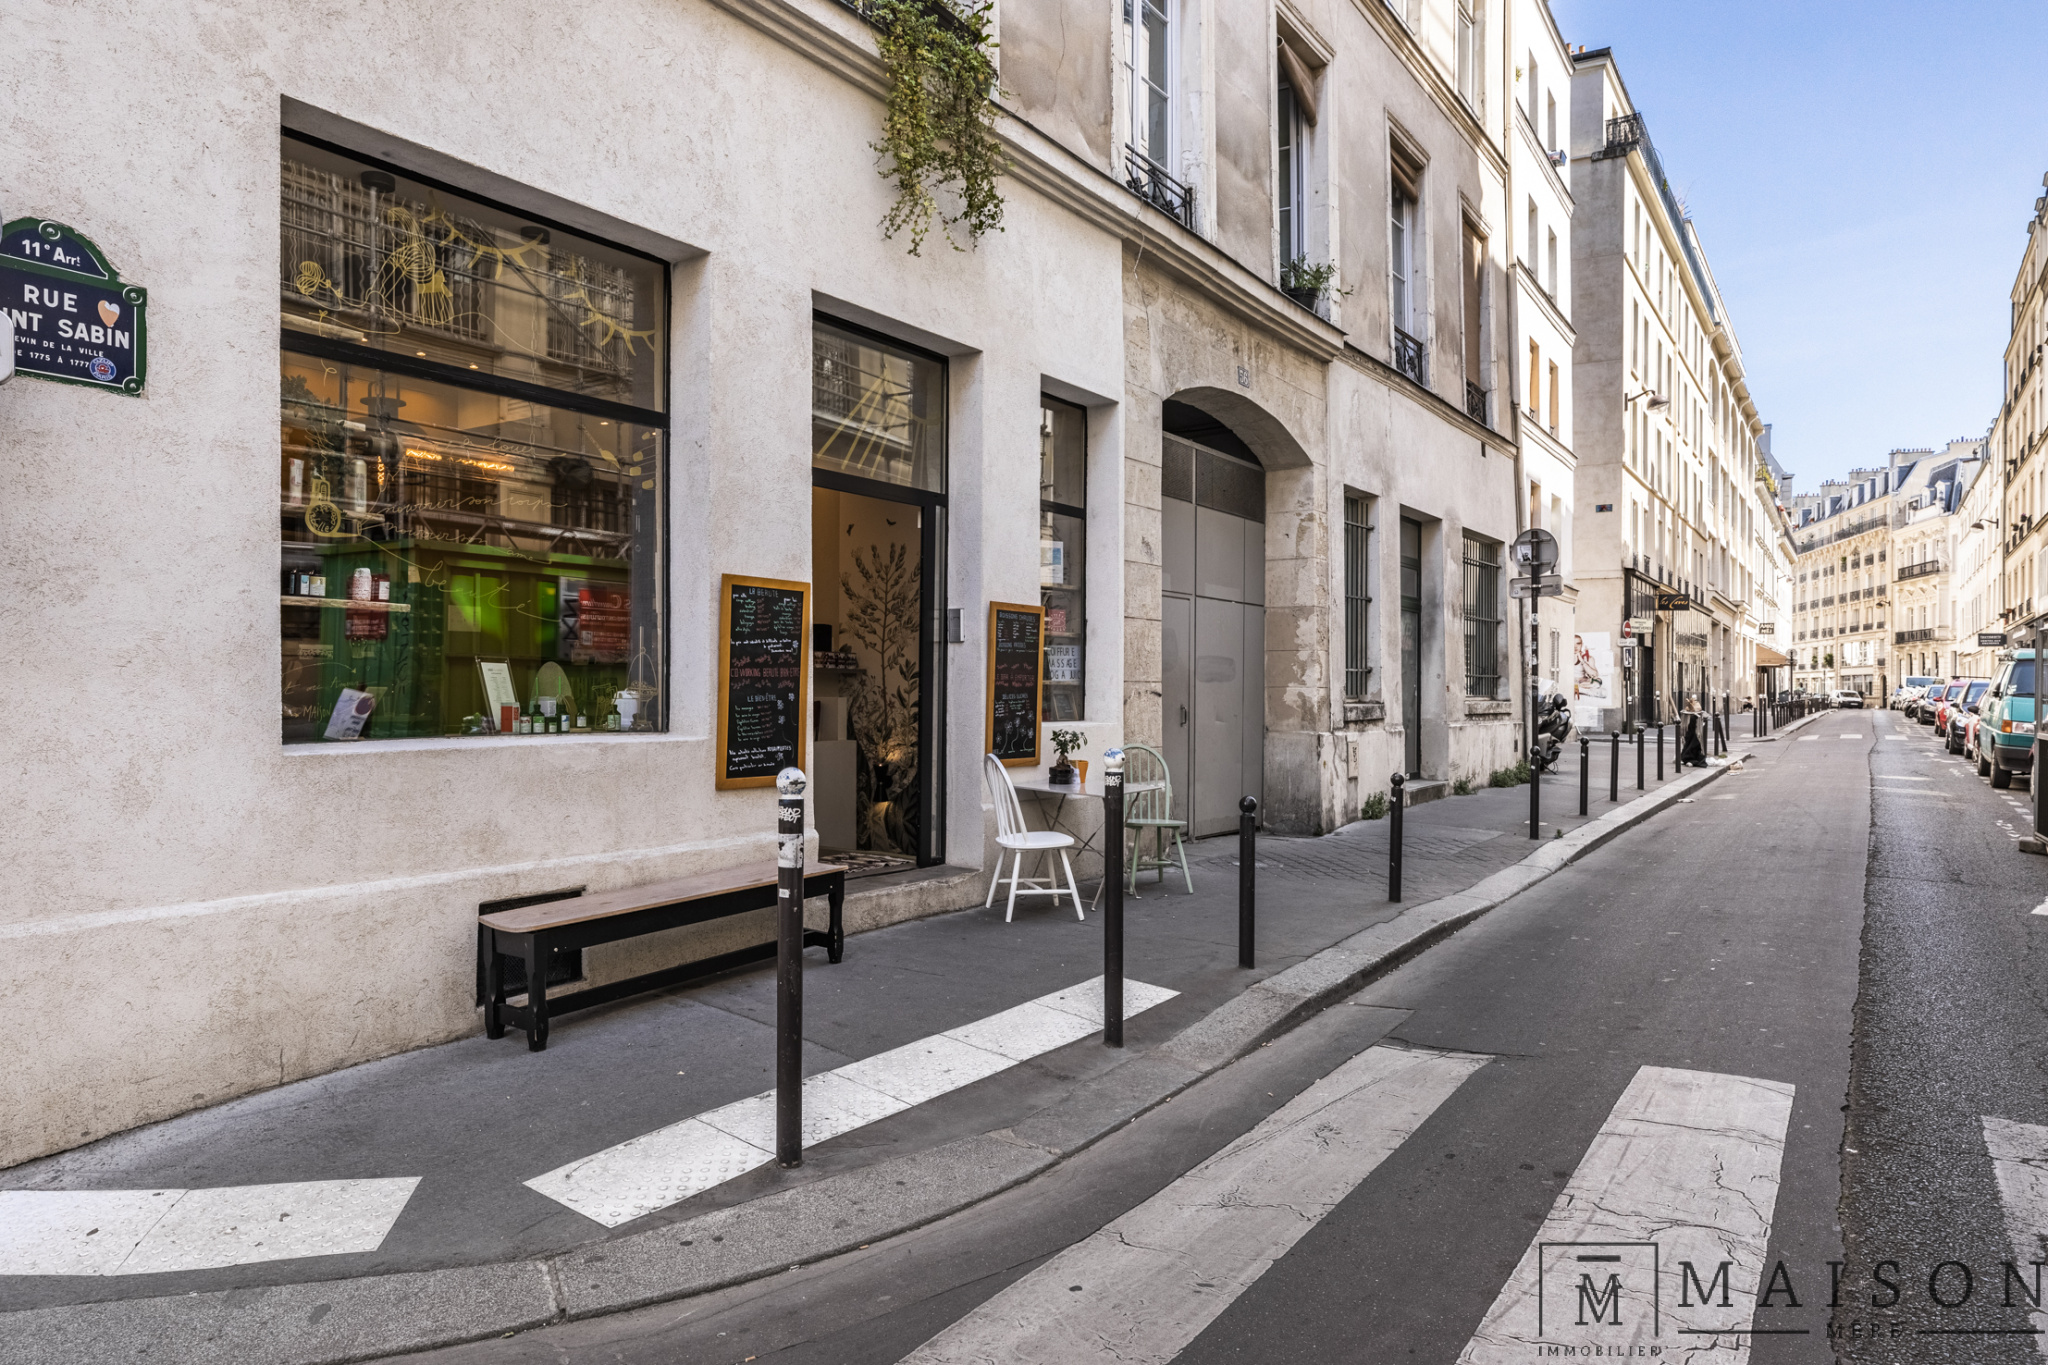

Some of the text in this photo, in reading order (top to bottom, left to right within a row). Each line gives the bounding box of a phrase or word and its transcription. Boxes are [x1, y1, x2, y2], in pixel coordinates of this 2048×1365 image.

[24, 284, 78, 313] RUE
[58, 319, 130, 350] SABIN
[43, 340, 55, 348] DE
[61, 344, 72, 352] LA
[78, 347, 104, 357] VILLE
[29, 351, 51, 362] 1775
[70, 359, 90, 368] 1777
[1239, 369, 1249, 385] 56
